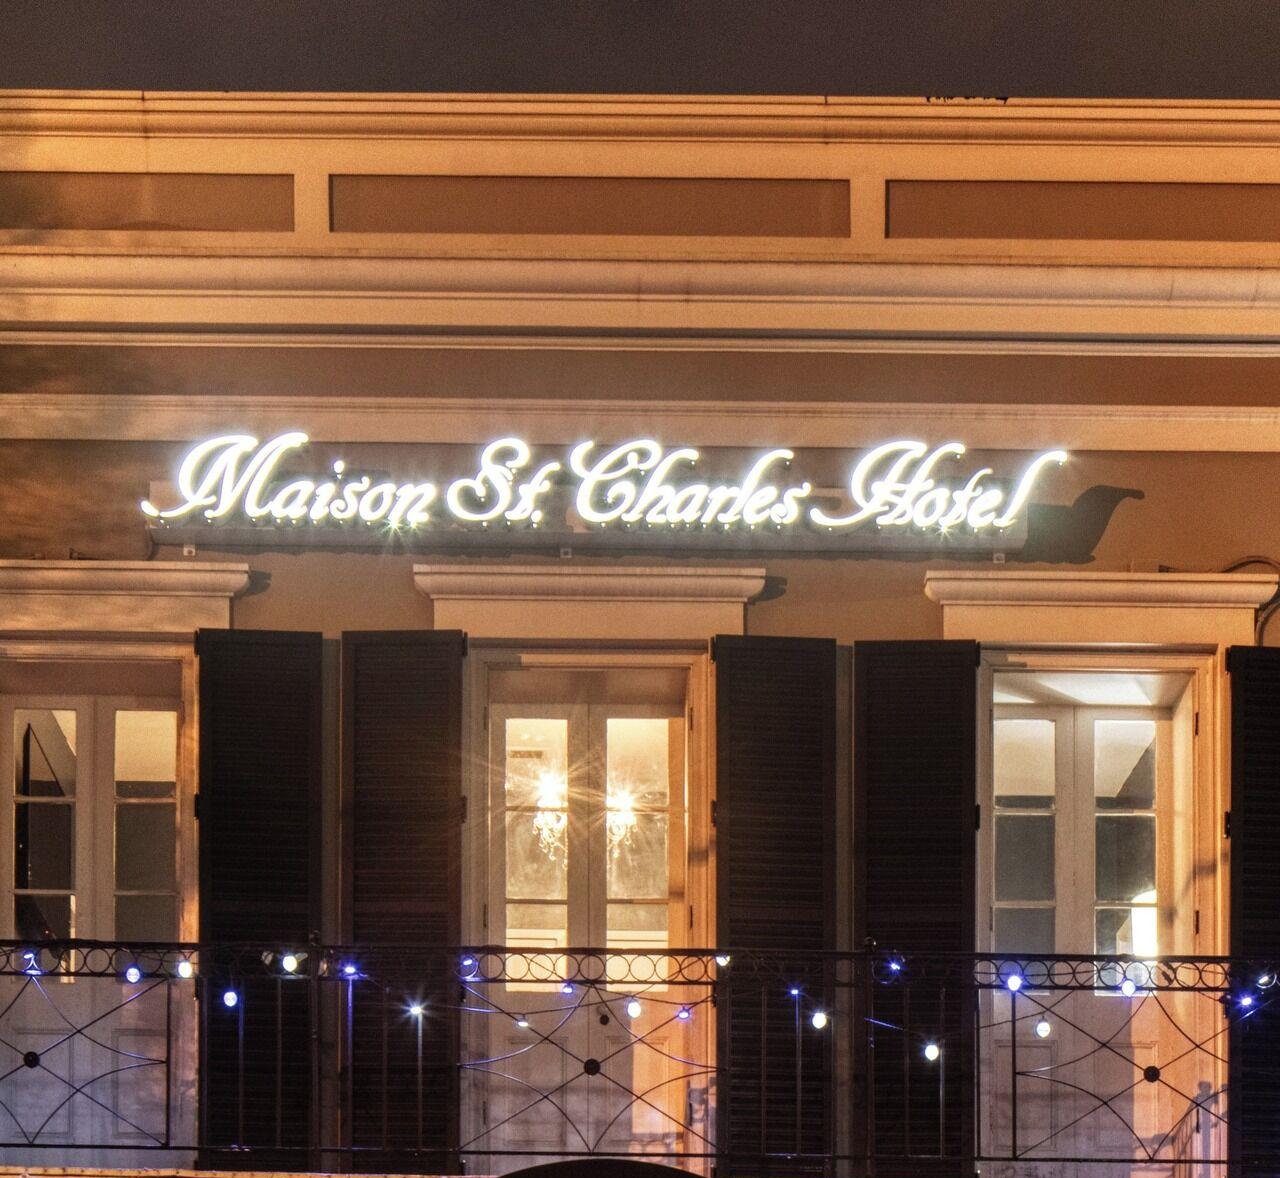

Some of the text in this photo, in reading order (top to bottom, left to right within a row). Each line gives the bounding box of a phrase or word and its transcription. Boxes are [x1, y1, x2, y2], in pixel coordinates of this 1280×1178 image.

[140, 431, 1068, 528] Maison St. Charles Hotel
